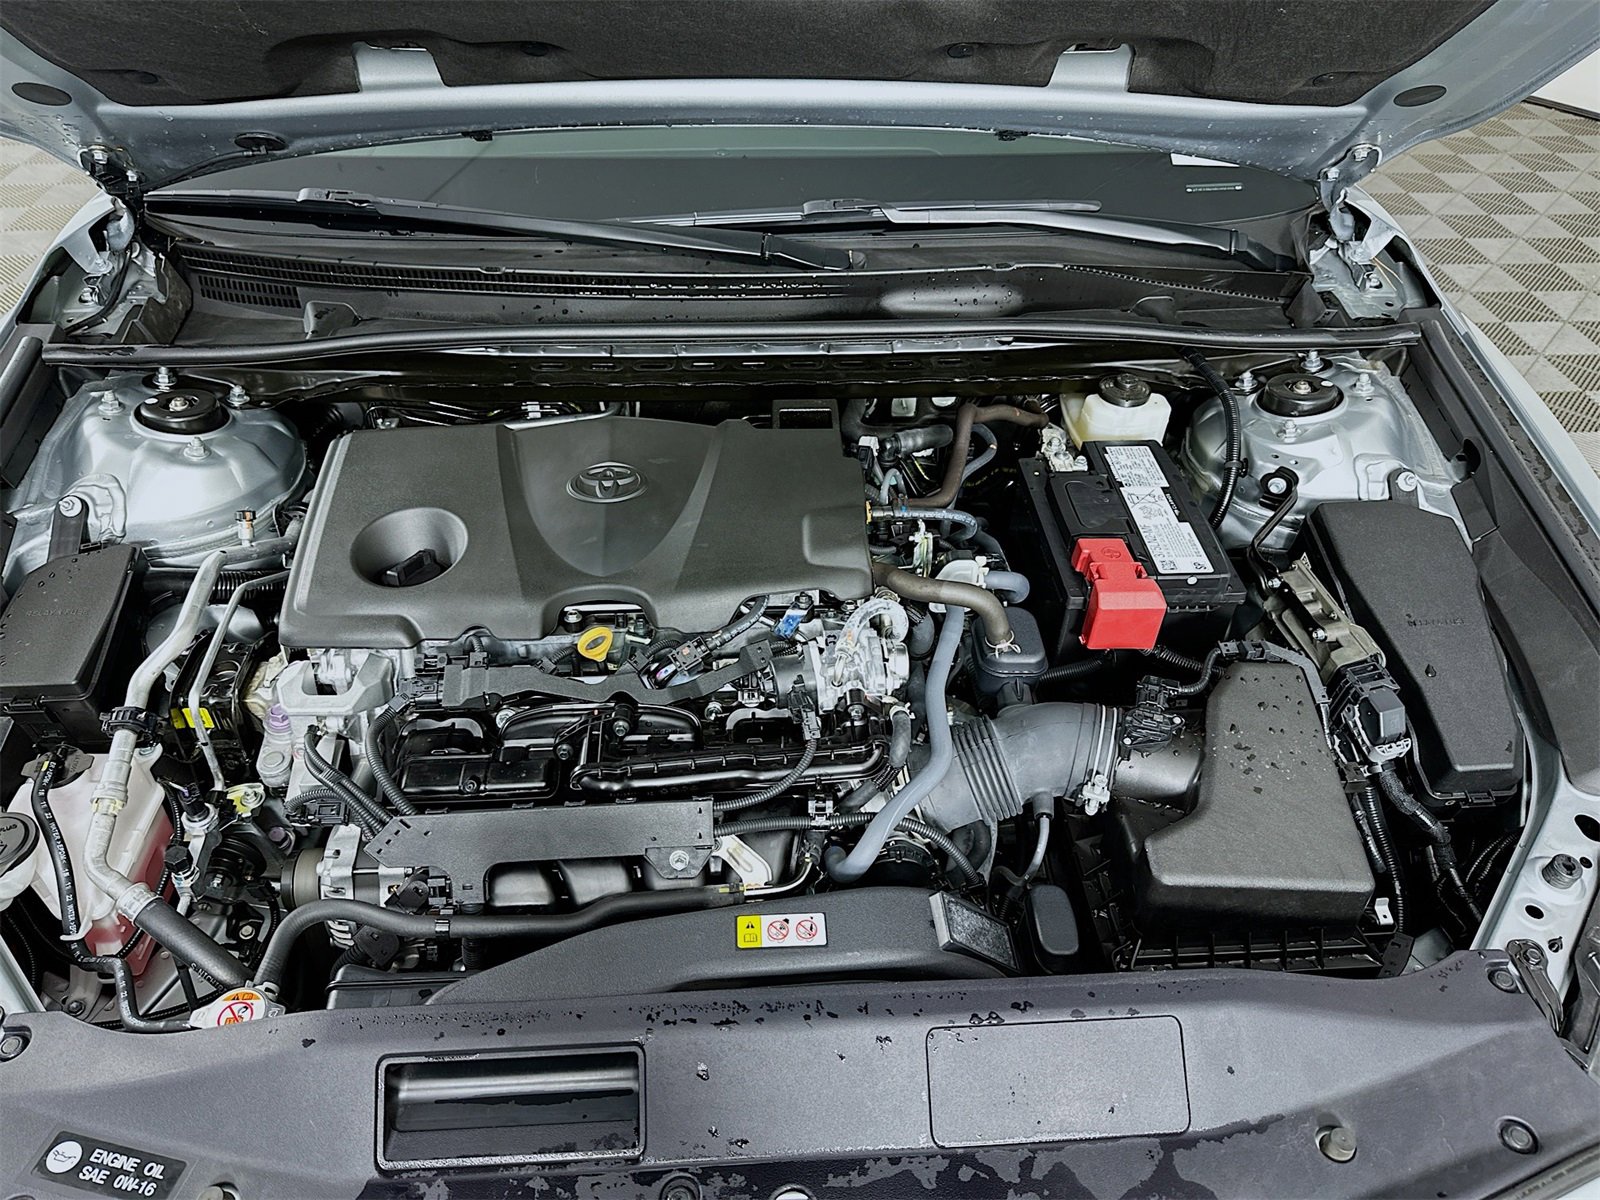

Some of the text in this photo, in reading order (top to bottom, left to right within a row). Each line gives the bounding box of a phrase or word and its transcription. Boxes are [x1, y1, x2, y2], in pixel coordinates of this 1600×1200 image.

[89, 1148, 165, 1180] ENGINE OIL
[78, 1165, 157, 1197] SAE 0W-16
